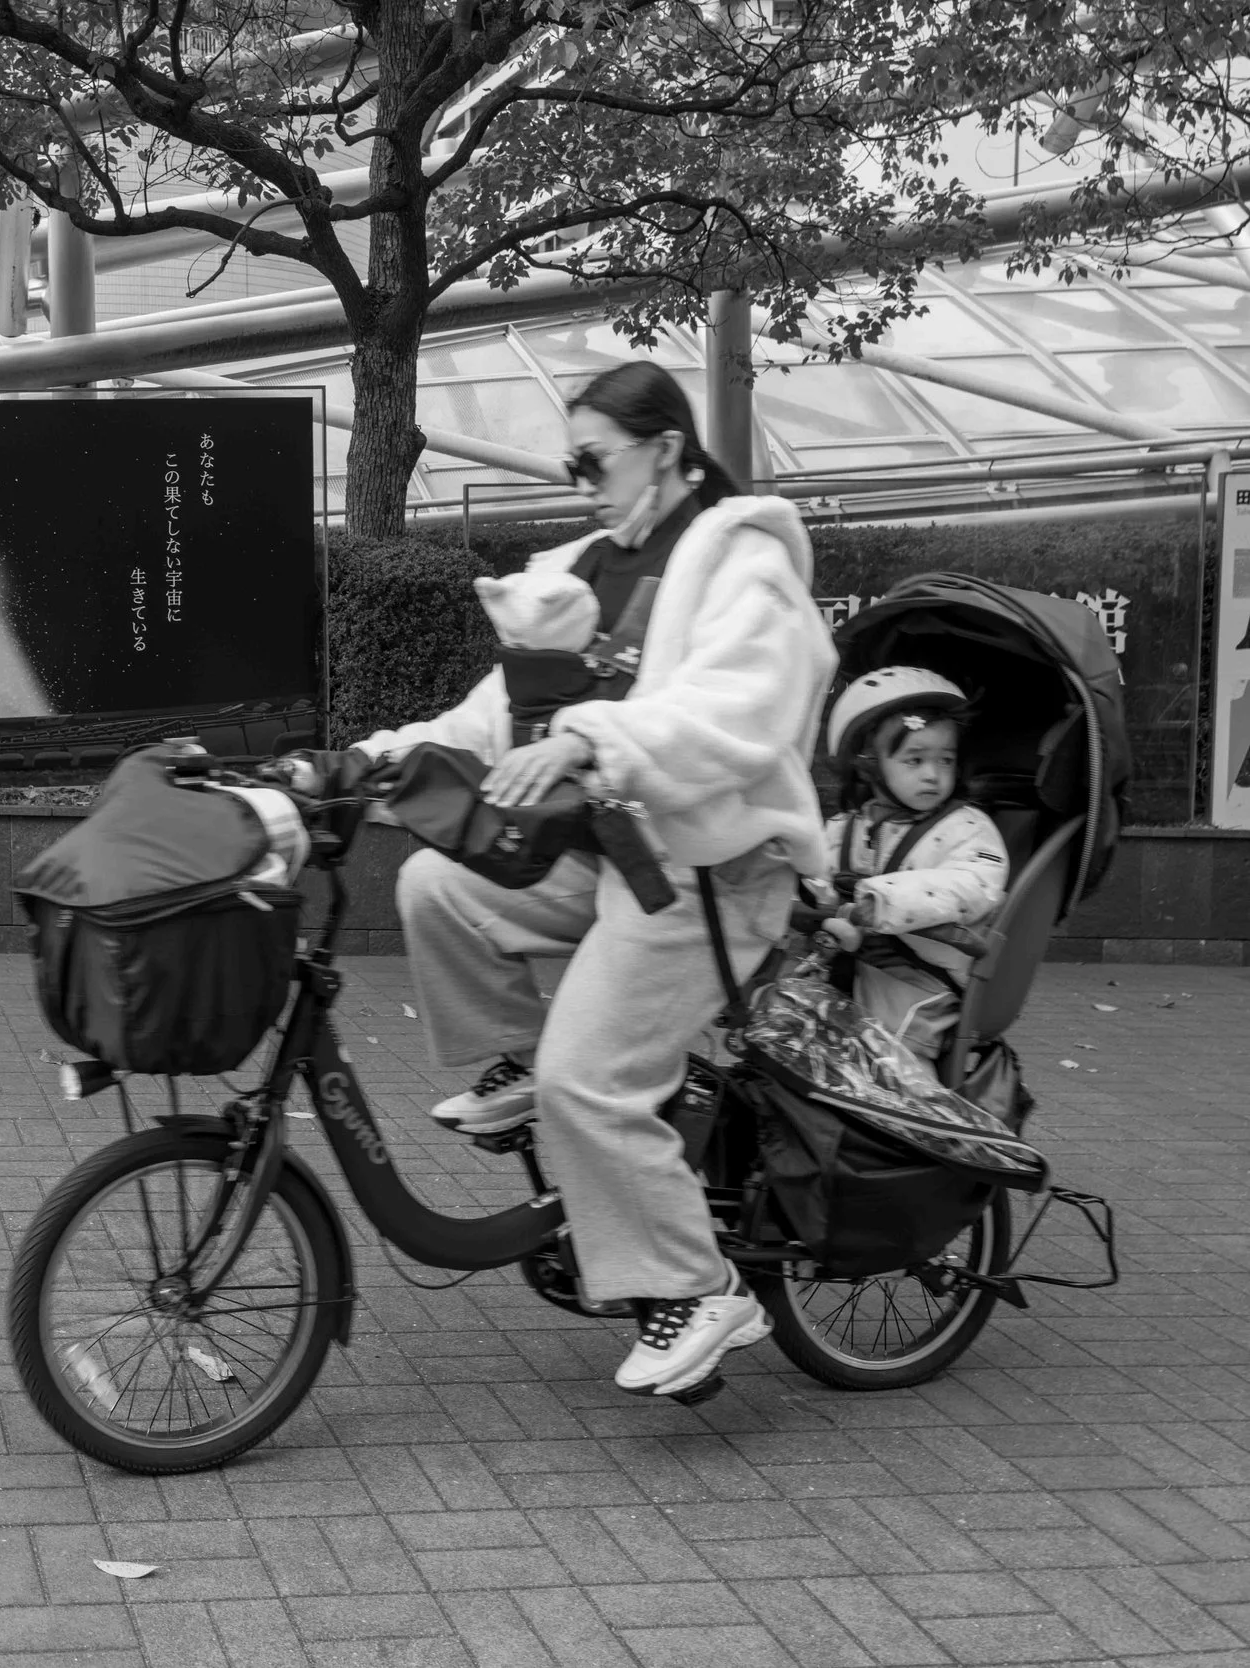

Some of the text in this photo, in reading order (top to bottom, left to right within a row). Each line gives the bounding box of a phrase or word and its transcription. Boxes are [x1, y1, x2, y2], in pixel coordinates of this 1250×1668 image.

[199, 432, 215, 506] あなたも
[163, 452, 183, 623] この果てしない宇宙に
[129, 567, 148, 652] 生きている
